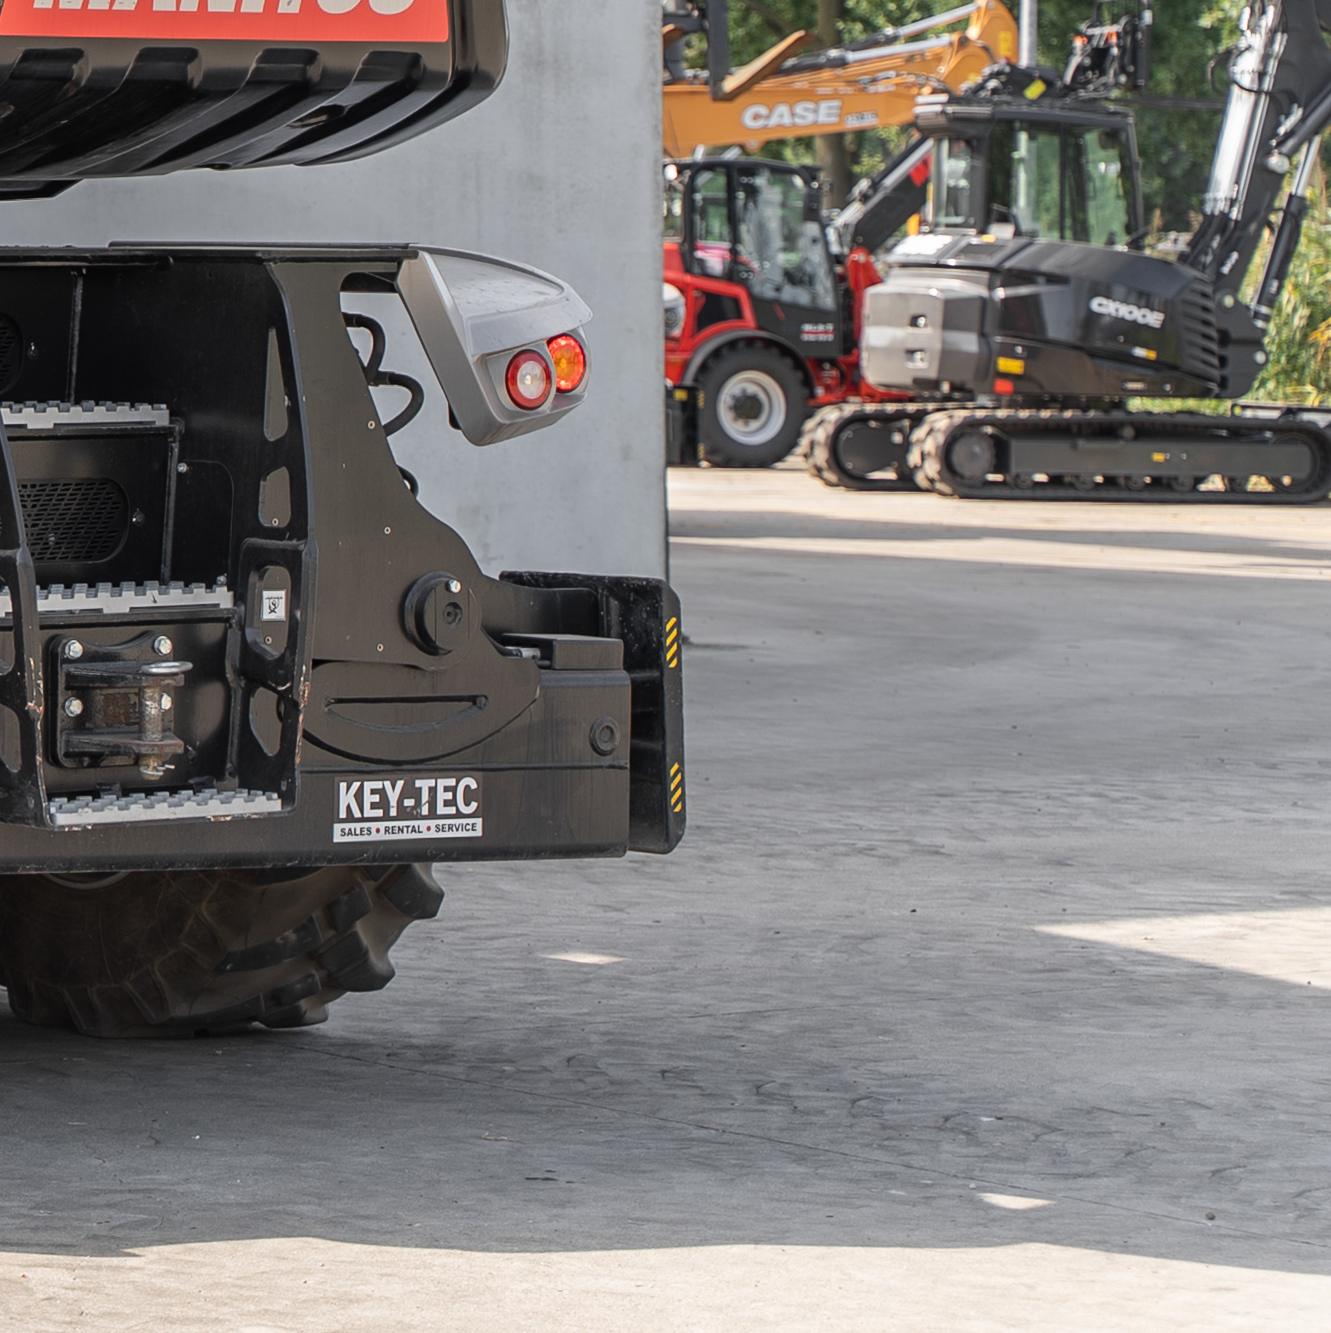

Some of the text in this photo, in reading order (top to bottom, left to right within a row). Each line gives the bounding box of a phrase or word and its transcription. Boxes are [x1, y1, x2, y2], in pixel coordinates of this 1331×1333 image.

[741, 99, 843, 129] CASE
[339, 777, 478, 818] KEY-TEC
[340, 822, 477, 837] SALES RENTAL SERVICE
